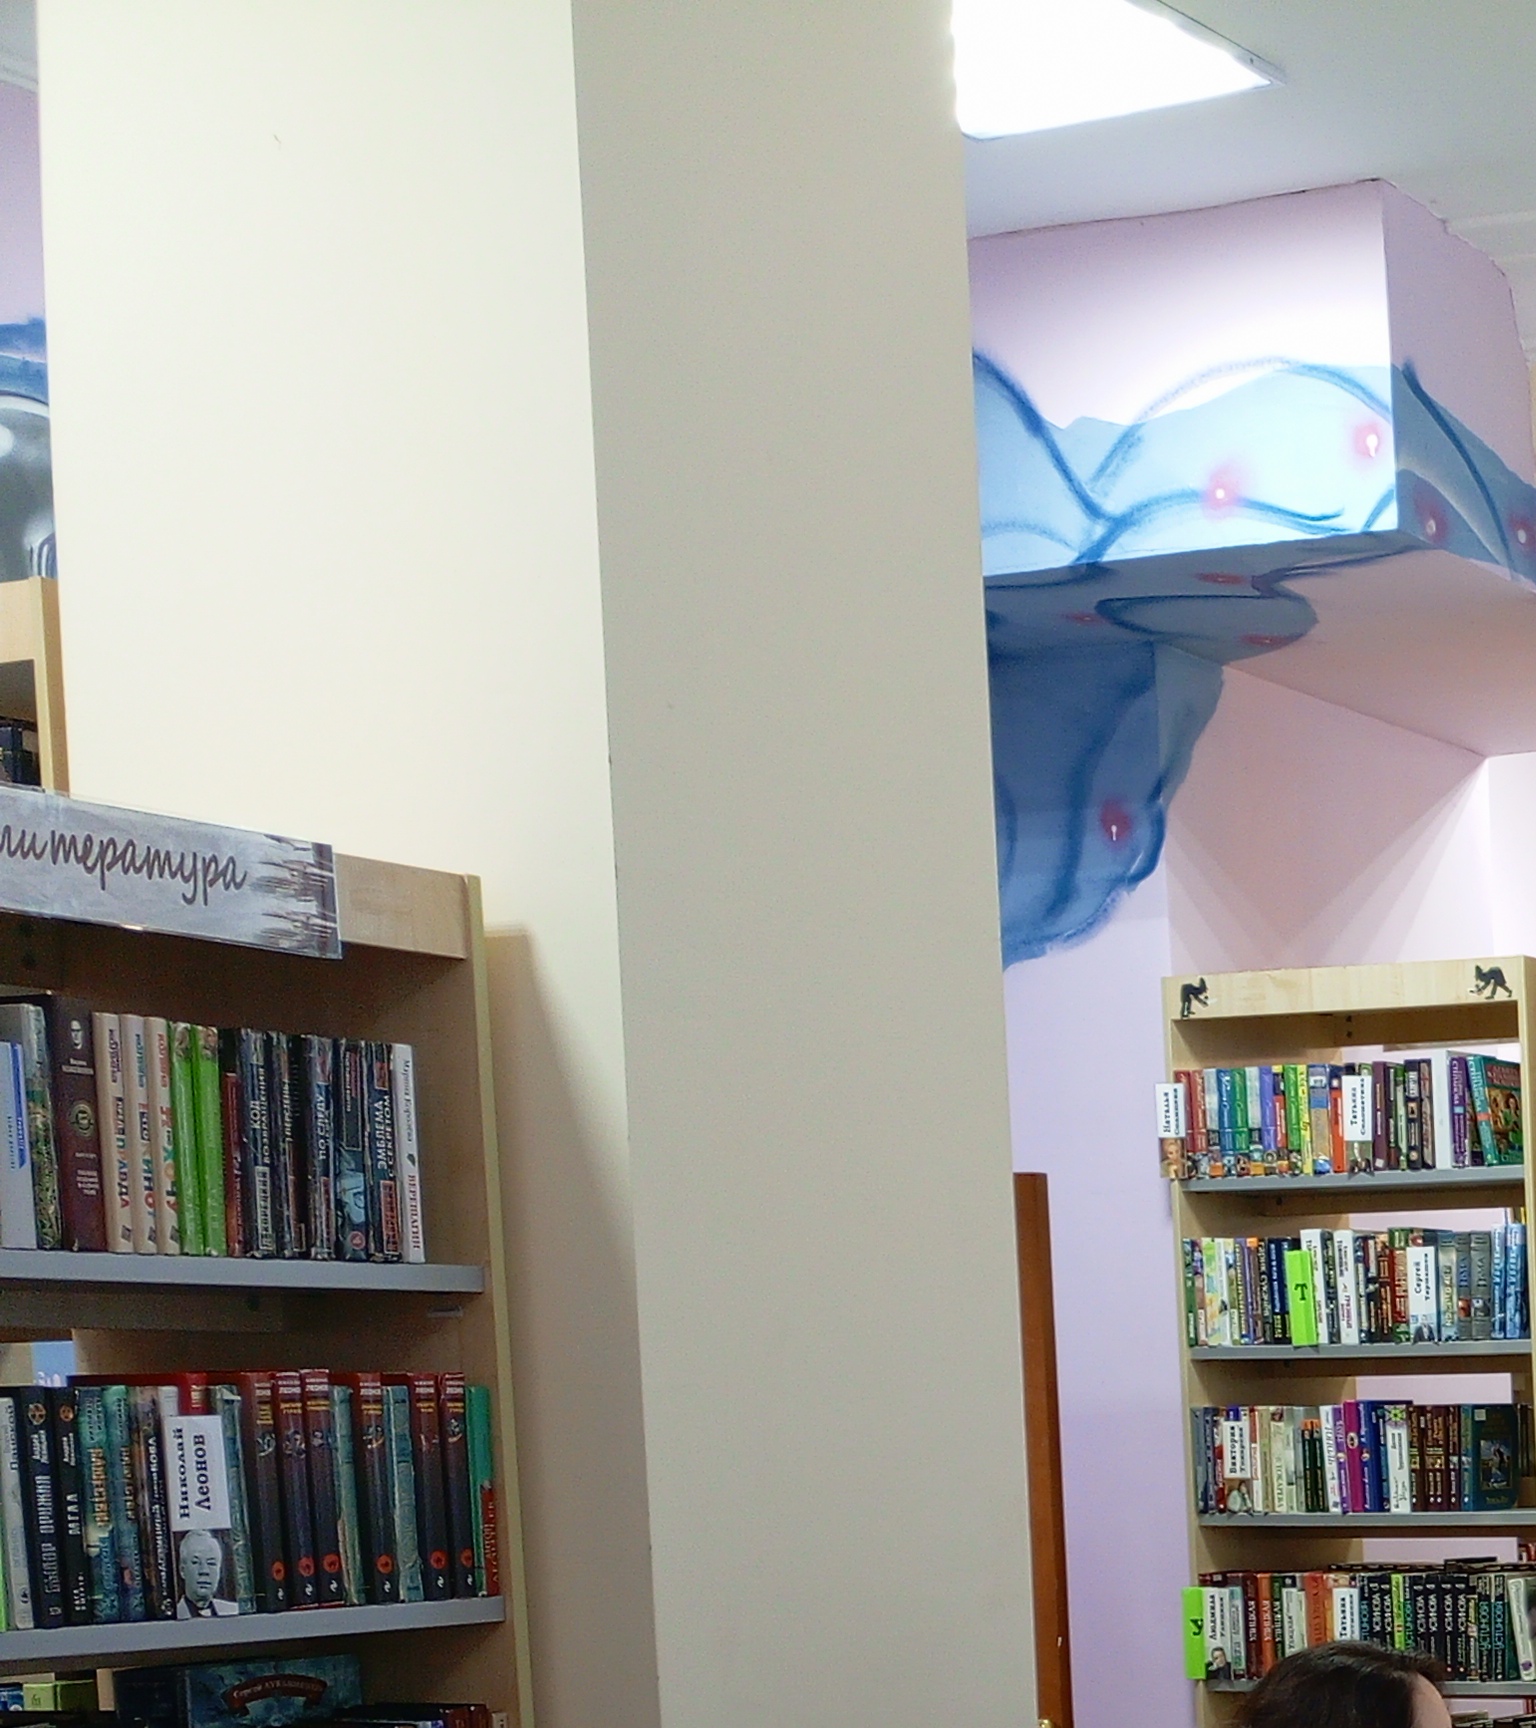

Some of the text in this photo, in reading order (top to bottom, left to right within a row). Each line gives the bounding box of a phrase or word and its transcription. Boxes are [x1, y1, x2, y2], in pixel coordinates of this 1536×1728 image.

[377, 1101, 388, 1170] ЭМБЛЕМА
[172, 1428, 190, 1520] Николай
[193, 1434, 211, 1511] Леонов
[1229, 1425, 1237, 1474] Виктория
[1209, 1594, 1217, 1641] Людмила
[1340, 1597, 1348, 1638] Татьяна
[1361, 1600, 1370, 1641] СТИНОВА
